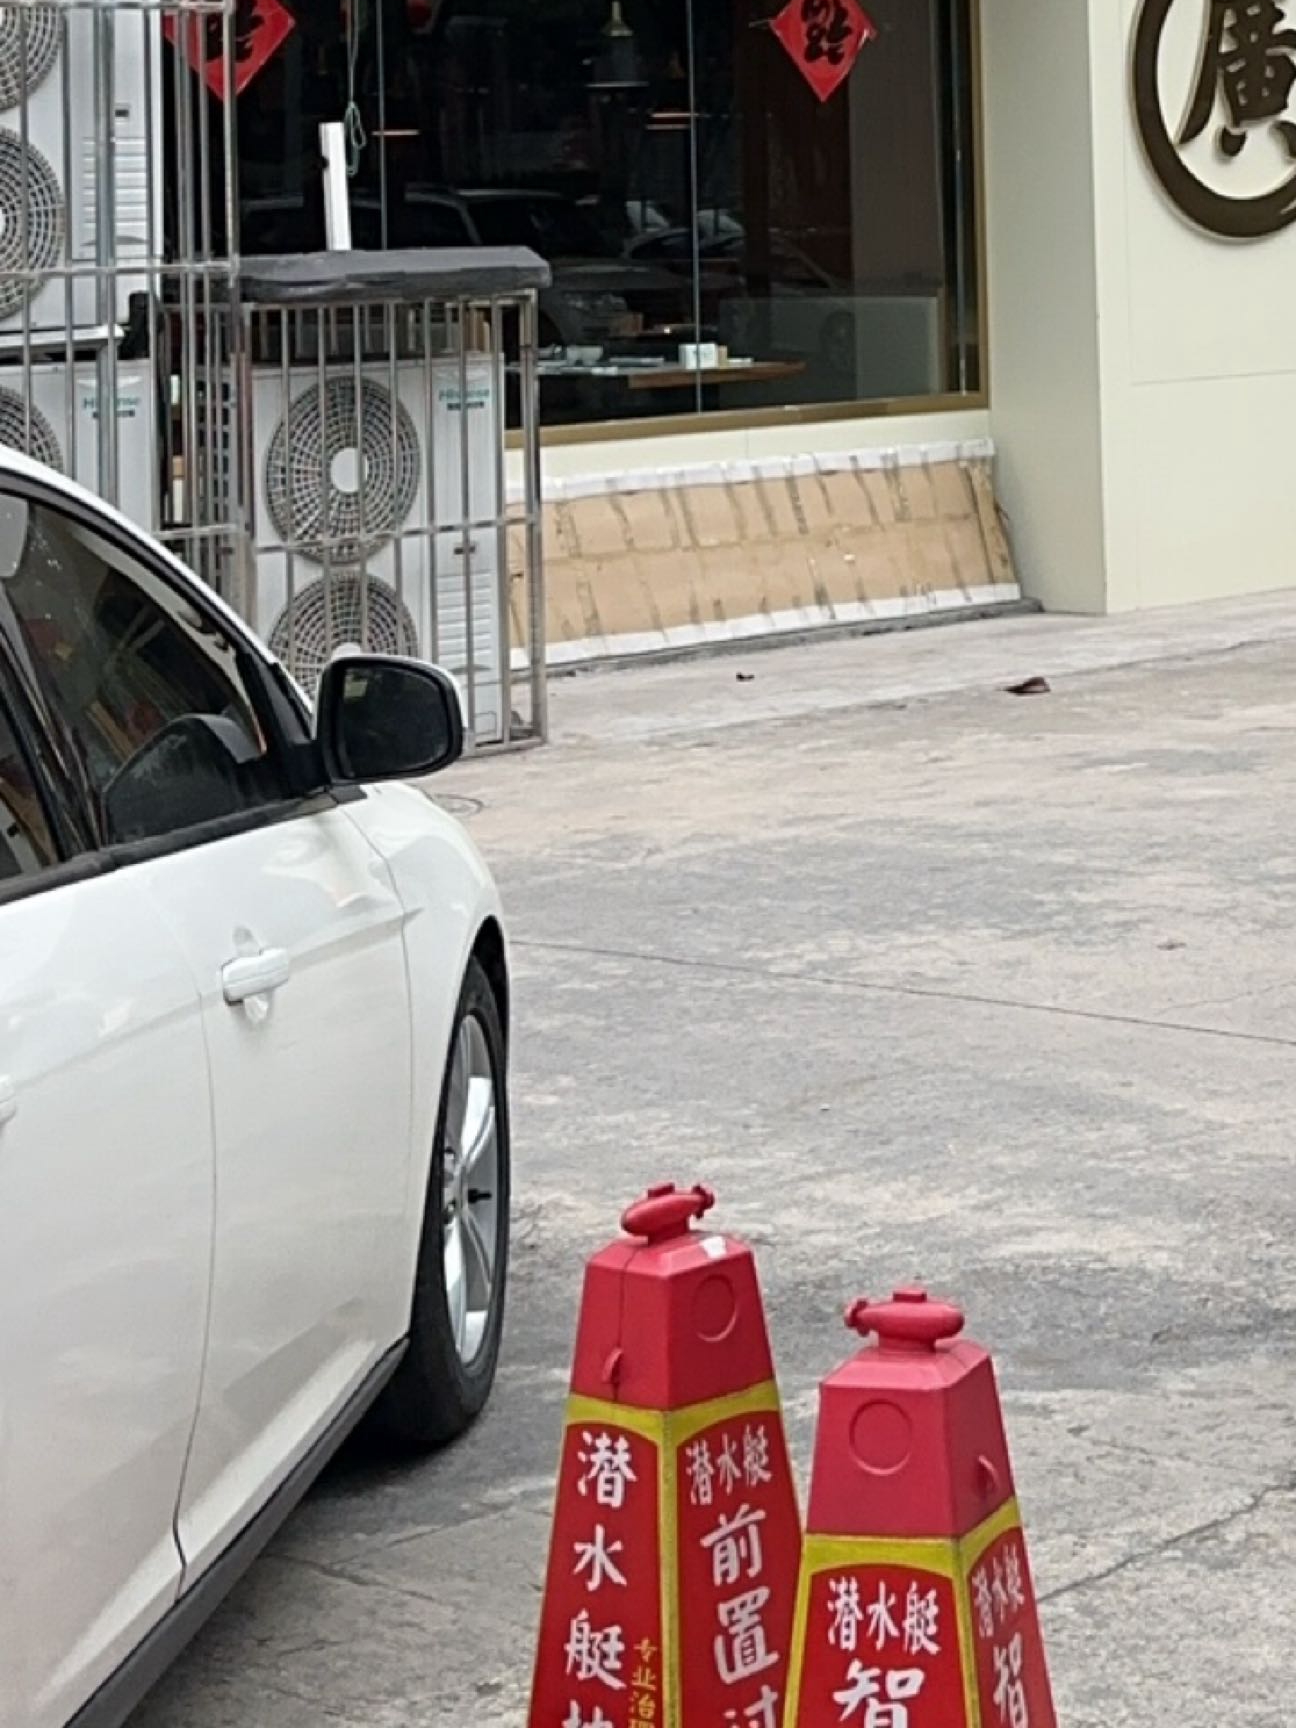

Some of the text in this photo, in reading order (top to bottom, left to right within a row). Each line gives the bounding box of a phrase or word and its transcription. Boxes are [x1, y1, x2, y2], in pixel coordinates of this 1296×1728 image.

[685, 1424, 773, 1506] 潜水艇
[826, 1575, 942, 1656] 潜水艇
[630, 1636, 658, 1728] 专业治
